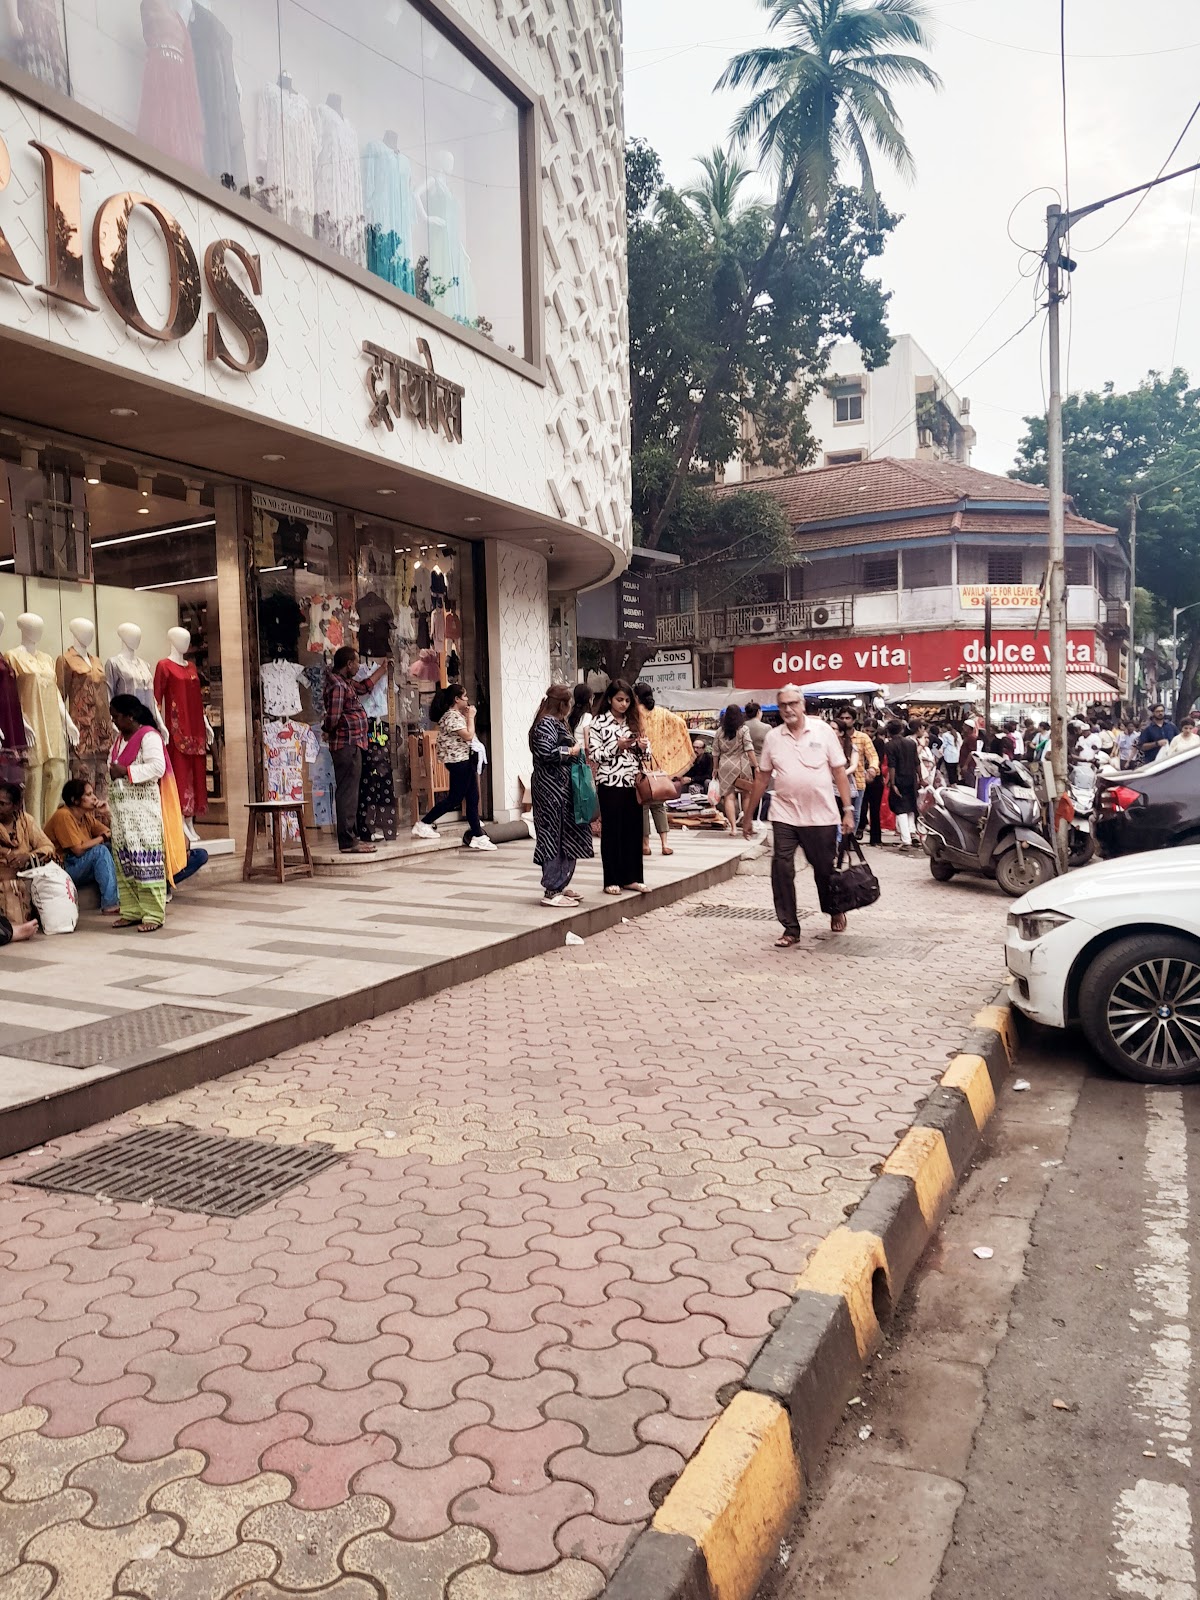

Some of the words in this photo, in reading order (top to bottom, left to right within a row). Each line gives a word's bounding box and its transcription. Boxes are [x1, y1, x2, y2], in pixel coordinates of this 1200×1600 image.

[999, 586, 1012, 597] FOR
[1013, 586, 1034, 597] LEAVE
[663, 652, 686, 663] SONS
[772, 649, 843, 674] dolce
[854, 644, 906, 668] vita
[963, 640, 1036, 662] dolce
[1042, 640, 1090, 662] vta
